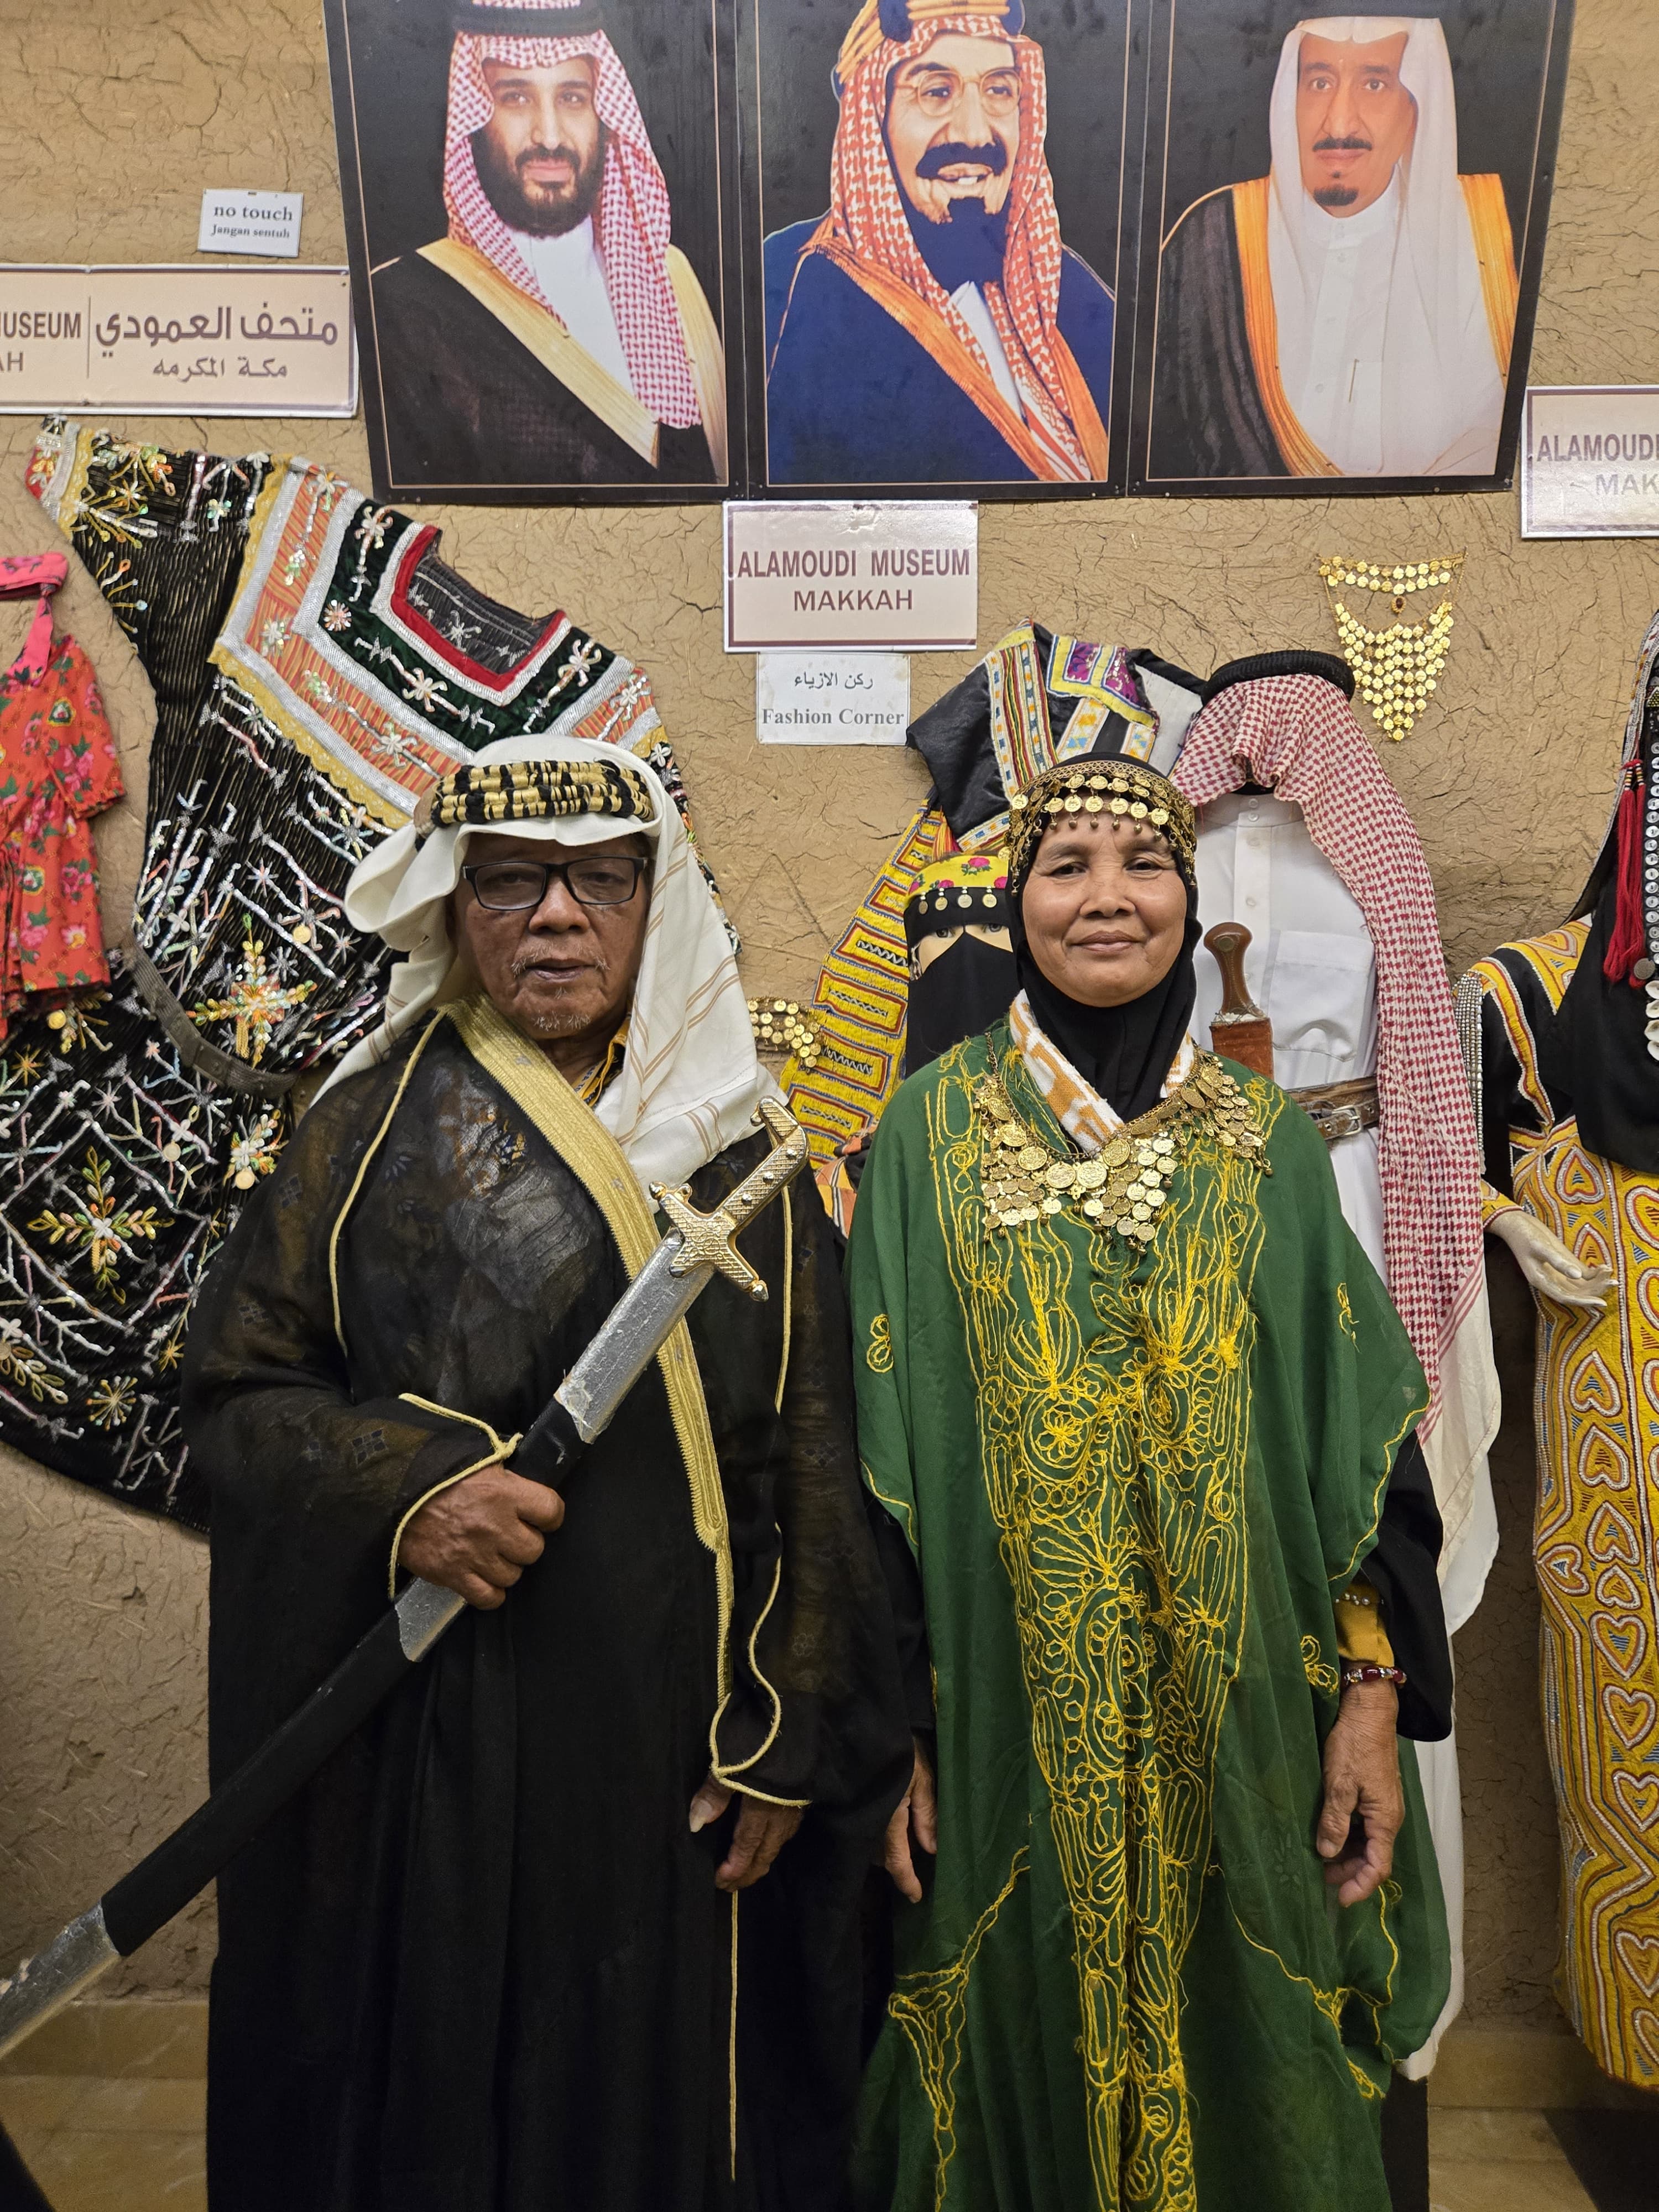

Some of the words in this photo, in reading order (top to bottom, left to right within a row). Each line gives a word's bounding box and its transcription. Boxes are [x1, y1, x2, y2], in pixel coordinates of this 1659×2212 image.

[214, 206, 236, 217] no
[243, 205, 293, 221] touch
[211, 224, 250, 238] Jangan
[253, 228, 290, 238] sentuh
[0, 311, 81, 340] USEUM
[96, 306, 231, 357] العمودي
[241, 302, 338, 345] متحف
[238, 356, 288, 377] مكة
[738, 550, 857, 578] ALAMOUDI
[871, 549, 970, 576] MUSEUM
[794, 589, 913, 611] MAKKAH
[844, 672, 873, 690] ركن
[761, 708, 832, 724] Fashion
[839, 708, 905, 725] Corner
